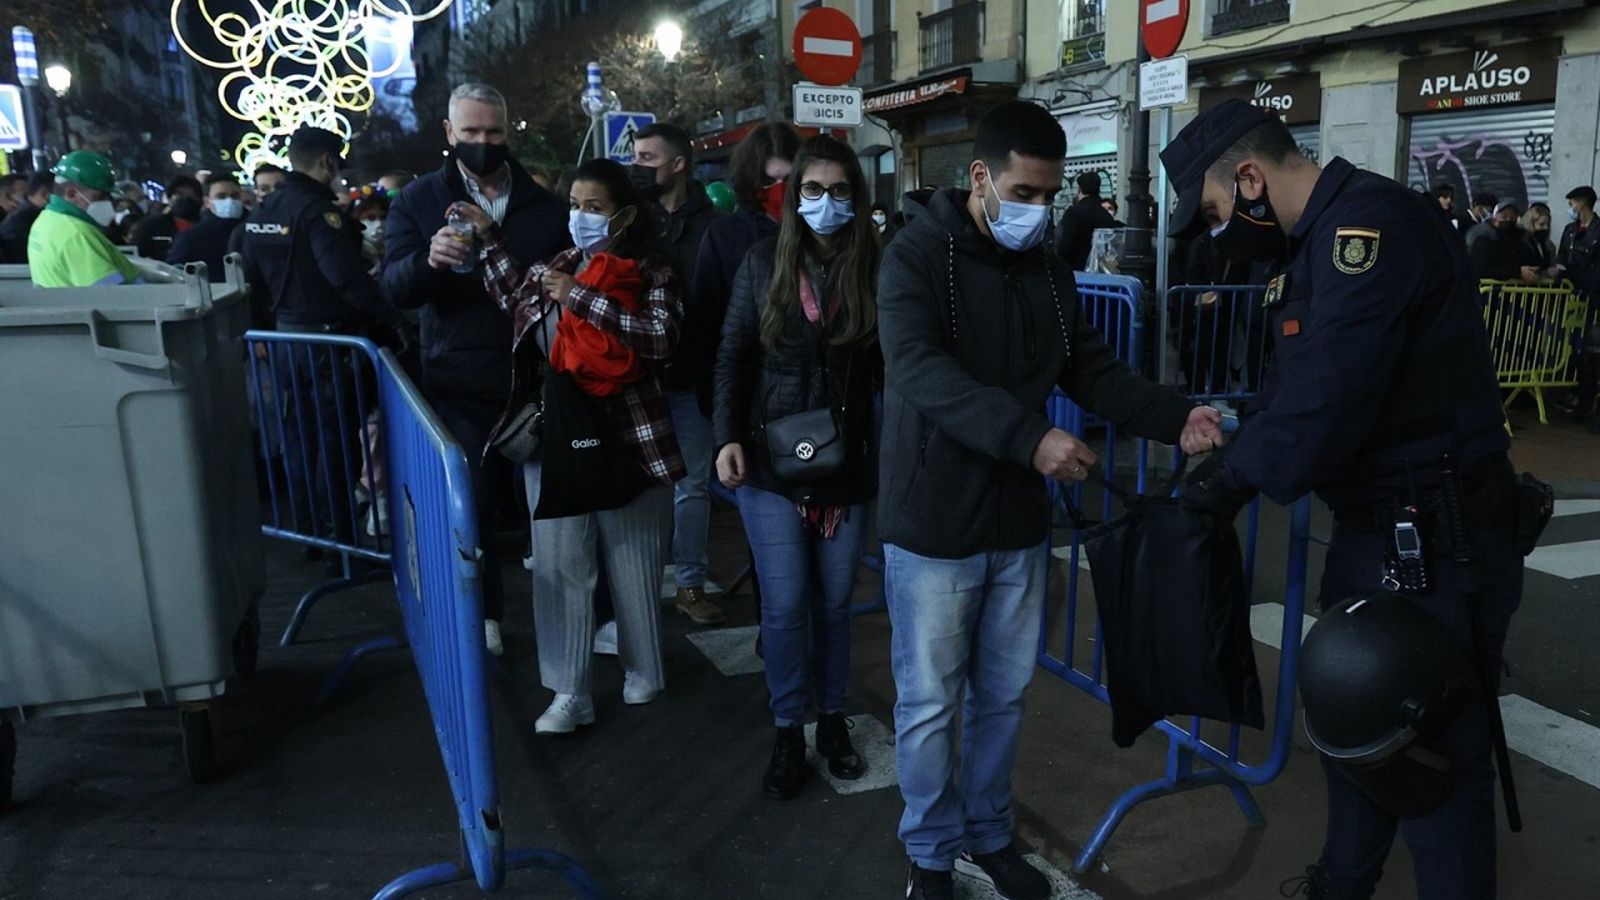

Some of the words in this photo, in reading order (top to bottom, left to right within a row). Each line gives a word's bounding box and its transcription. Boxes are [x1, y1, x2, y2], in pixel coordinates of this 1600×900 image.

[1419, 66, 1531, 96] APLAUSO
[802, 93, 854, 105] EXCEPTO
[1464, 95, 1489, 106] SHOE
[1490, 91, 1521, 103] STORE
[815, 108, 844, 118] BICIS
[245, 223, 283, 234] POLICIA
